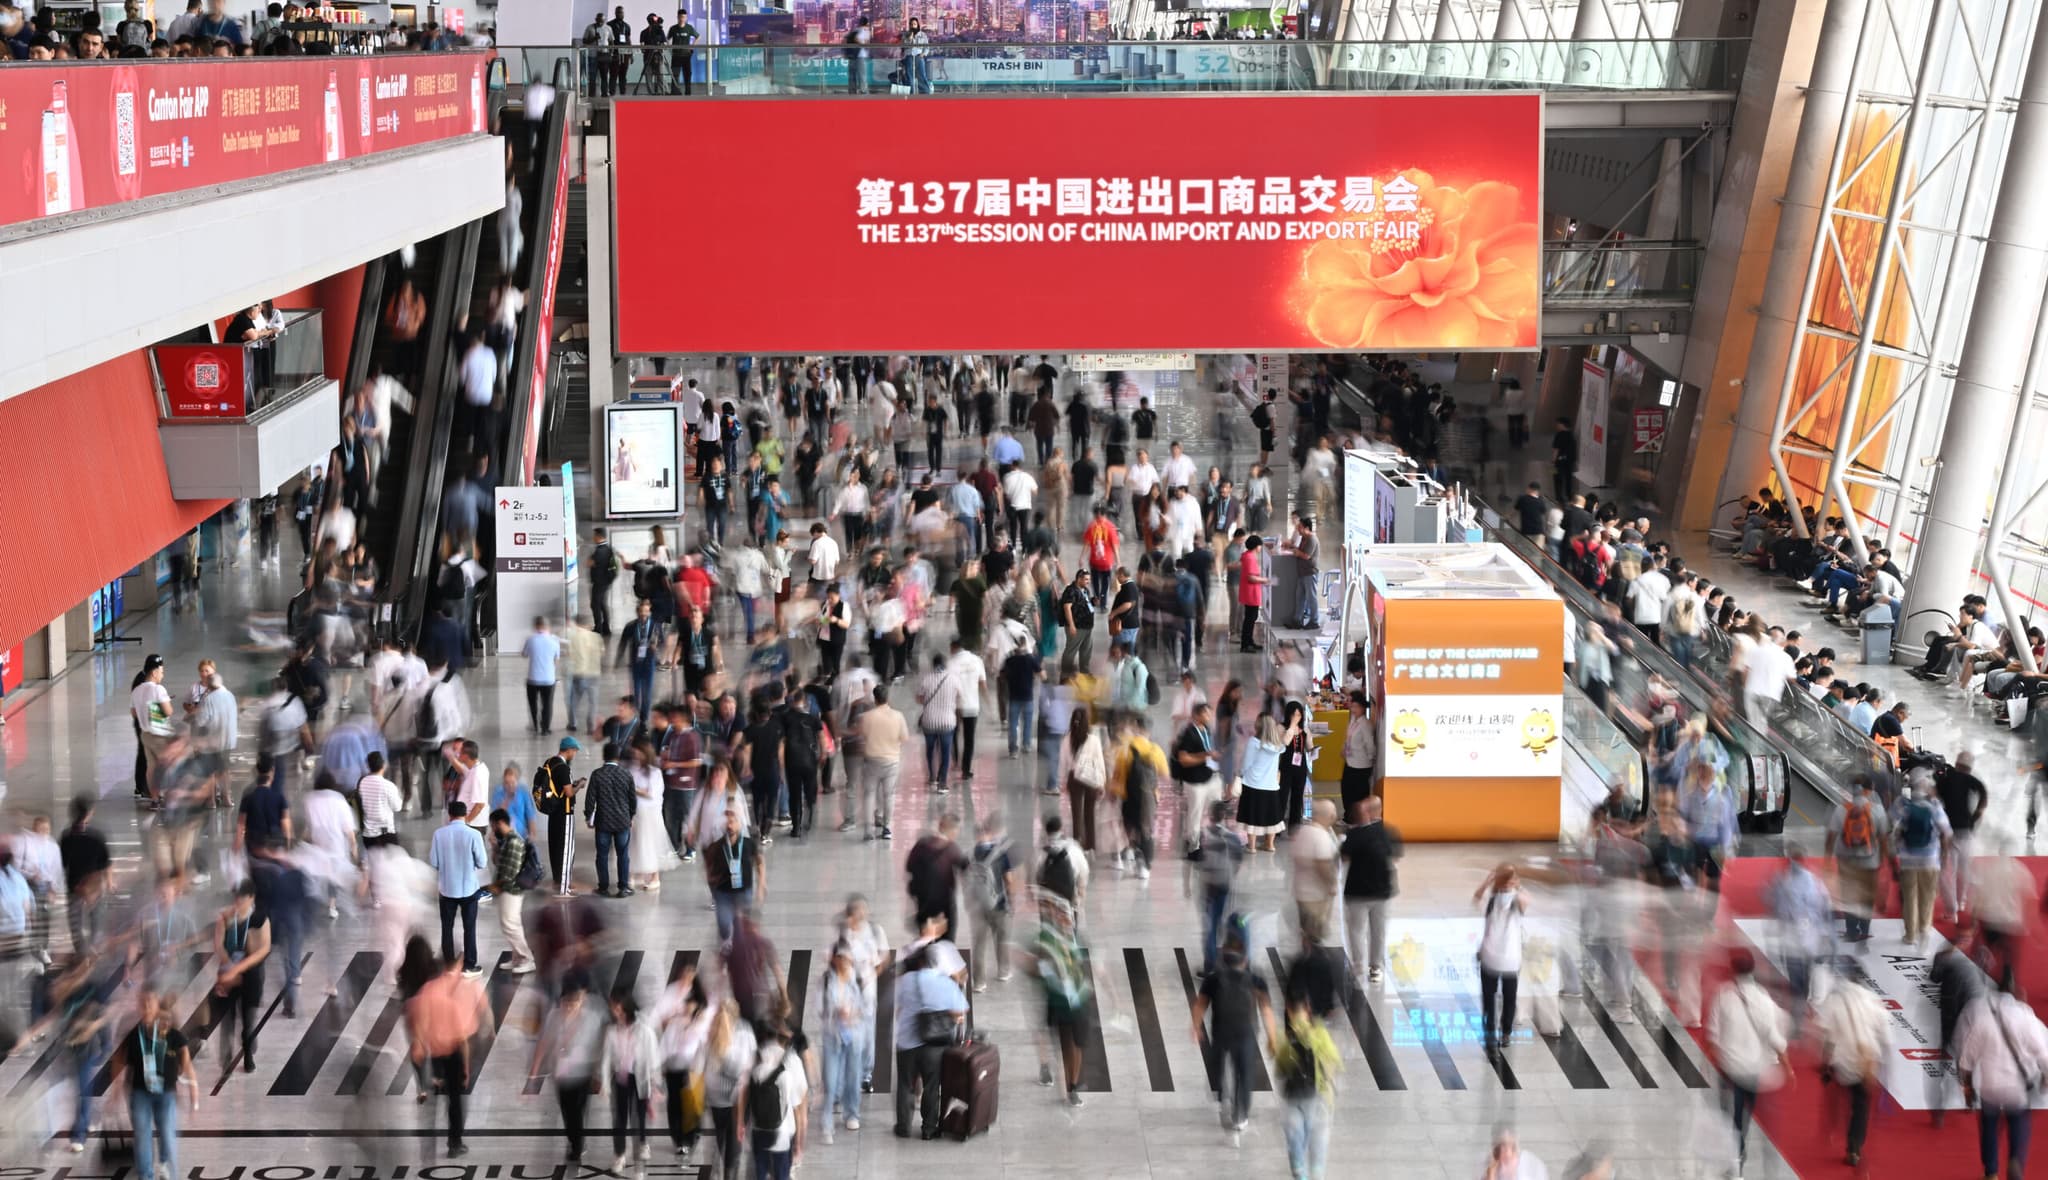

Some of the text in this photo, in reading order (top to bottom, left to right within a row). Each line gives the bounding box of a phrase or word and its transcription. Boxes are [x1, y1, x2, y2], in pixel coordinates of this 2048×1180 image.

[982, 61, 1043, 71] TRASH BIN
[1196, 55, 1230, 73] 3.2
[376, 73, 408, 100] Canton Fair APP
[149, 86, 209, 122] Canton Fair APP
[856, 176, 1419, 217] 第137届中国进出口商品交易会
[858, 224, 900, 243] THE
[1048, 224, 1077, 243] OF
[1081, 223, 1147, 242] CHINA
[1151, 222, 1233, 241] IMPORT
[1236, 222, 1281, 241] AND
[1285, 221, 1369, 240] EXPORT
[1373, 221, 1420, 239] FAIR
[513, 501, 525, 510] 2F
[1428, 648, 1443, 659] OF
[1445, 648, 1465, 659] THE
[1466, 648, 1512, 659] CANTON
[1513, 648, 1539, 659] FAIR
